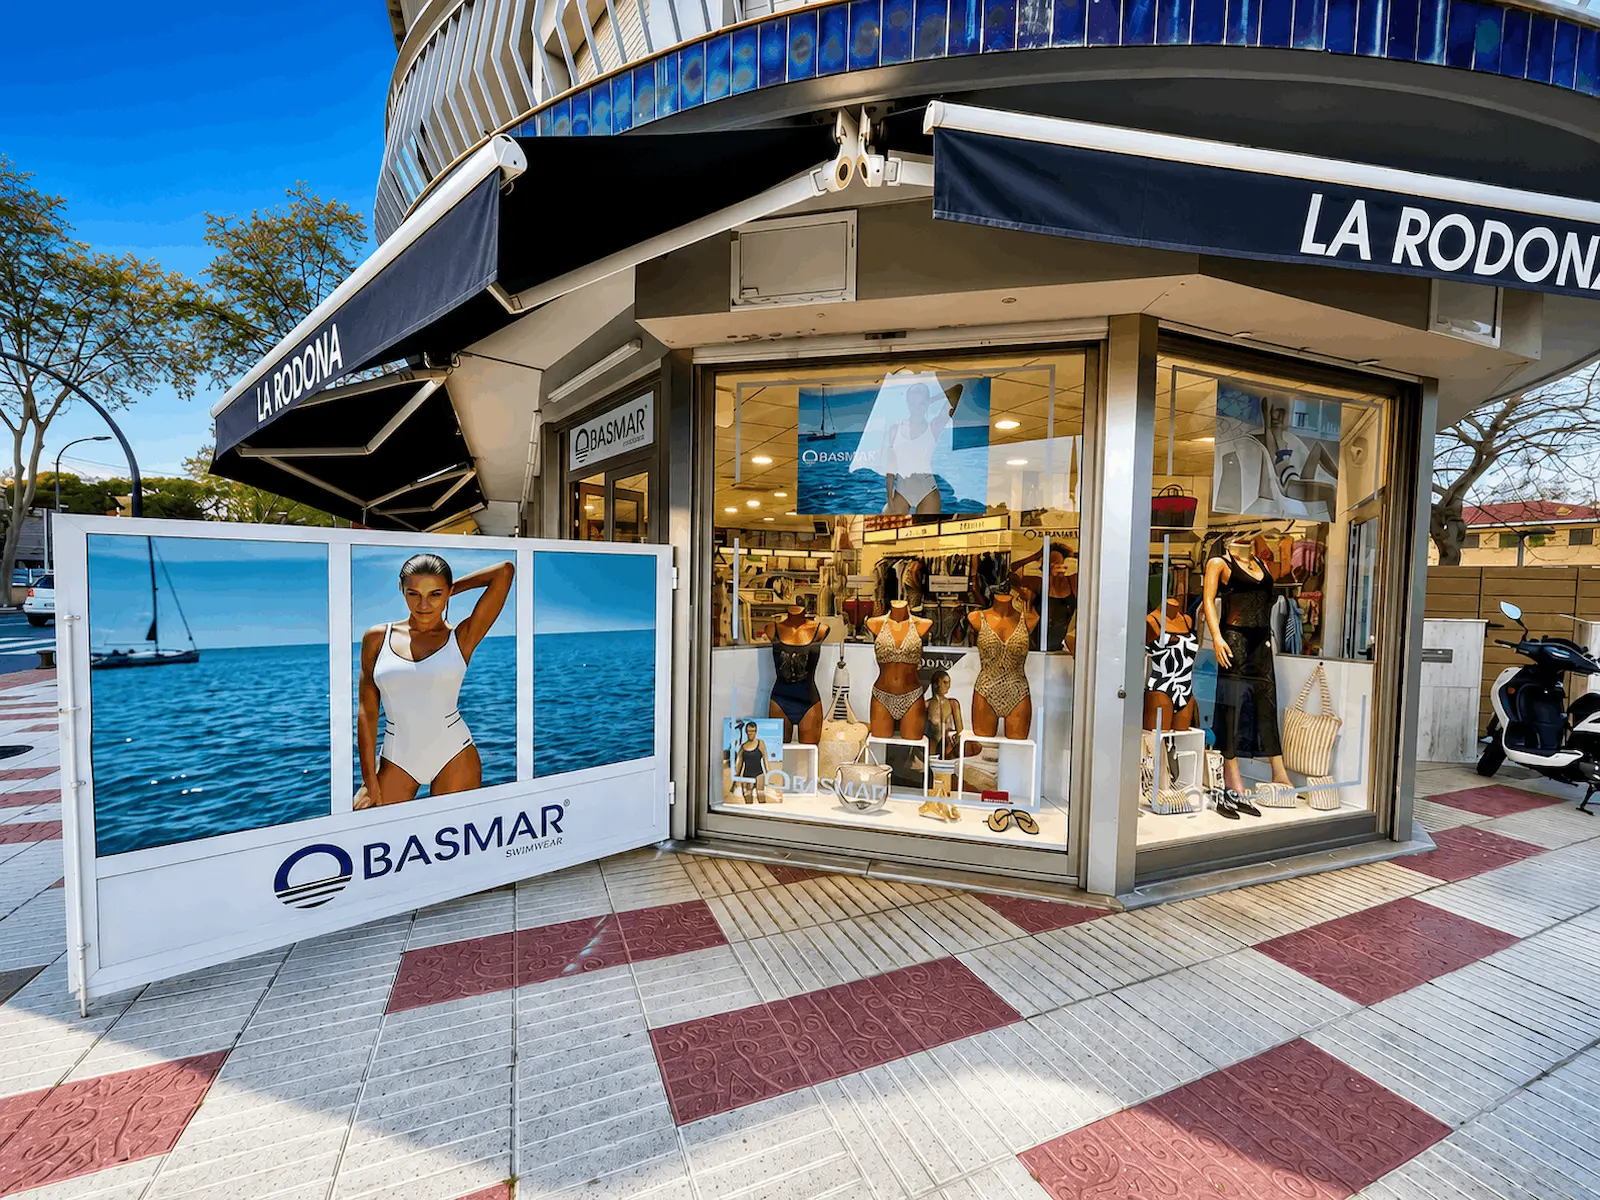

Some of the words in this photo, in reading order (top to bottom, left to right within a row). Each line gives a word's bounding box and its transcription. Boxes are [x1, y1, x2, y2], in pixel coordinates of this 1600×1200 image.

[1299, 193, 1372, 261] LA
[256, 381, 272, 423] LA
[273, 323, 343, 412] RODONA
[505, 837, 563, 858] SWIMWEAR
